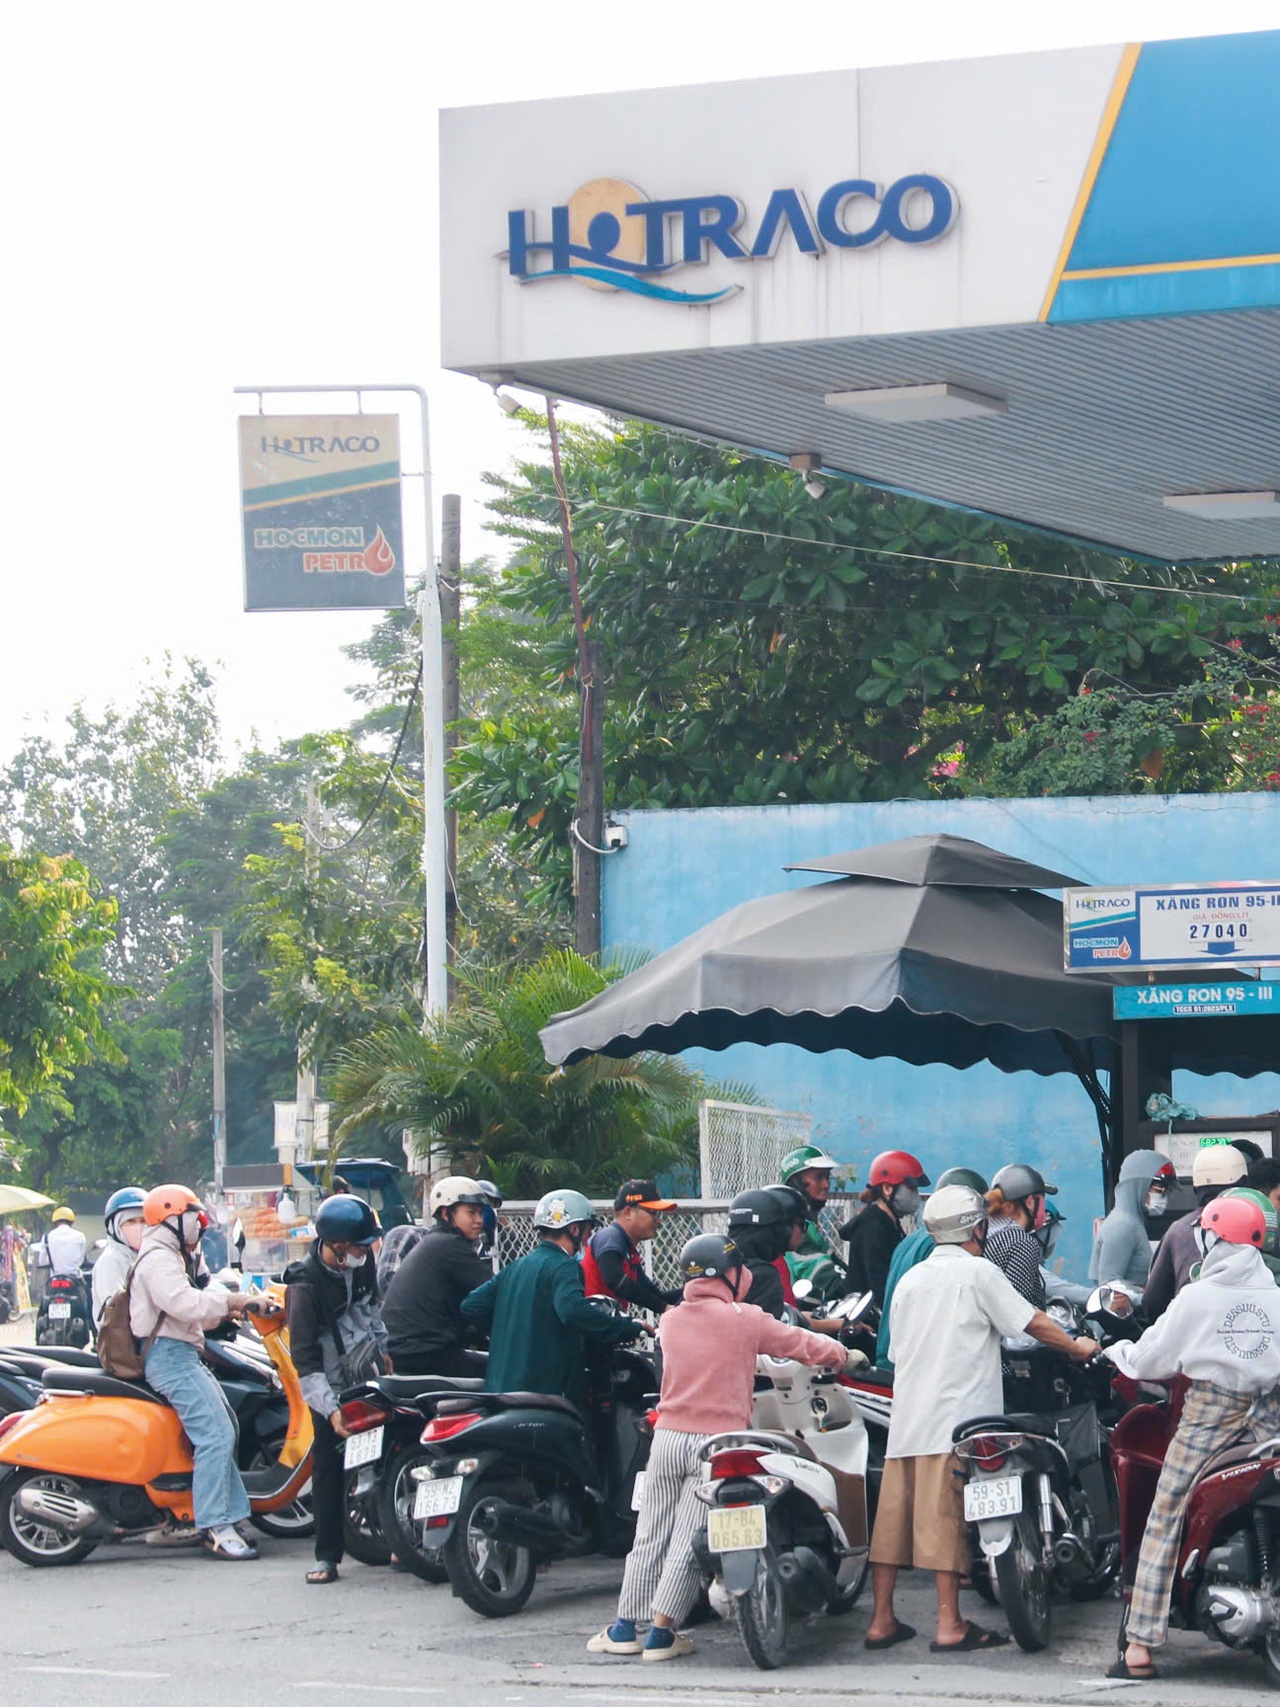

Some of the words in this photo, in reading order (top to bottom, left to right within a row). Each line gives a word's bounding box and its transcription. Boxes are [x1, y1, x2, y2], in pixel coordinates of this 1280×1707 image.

[508, 174, 956, 277] HOTRACO
[260, 435, 380, 455] HOTRACO
[254, 526, 364, 549] HOCMON
[1156, 896, 1200, 911] XĂNG
[1206, 896, 1240, 909] RON
[1189, 923, 1248, 939] 27040
[1073, 937, 1119, 949] HOCMON
[1137, 987, 1183, 1004] XĂNG
[1187, 988, 1224, 1003] RON
[1226, 987, 1245, 1001] 95
[1258, 986, 1273, 1000] III
[972, 1480, 1012, 1502] 59-S1
